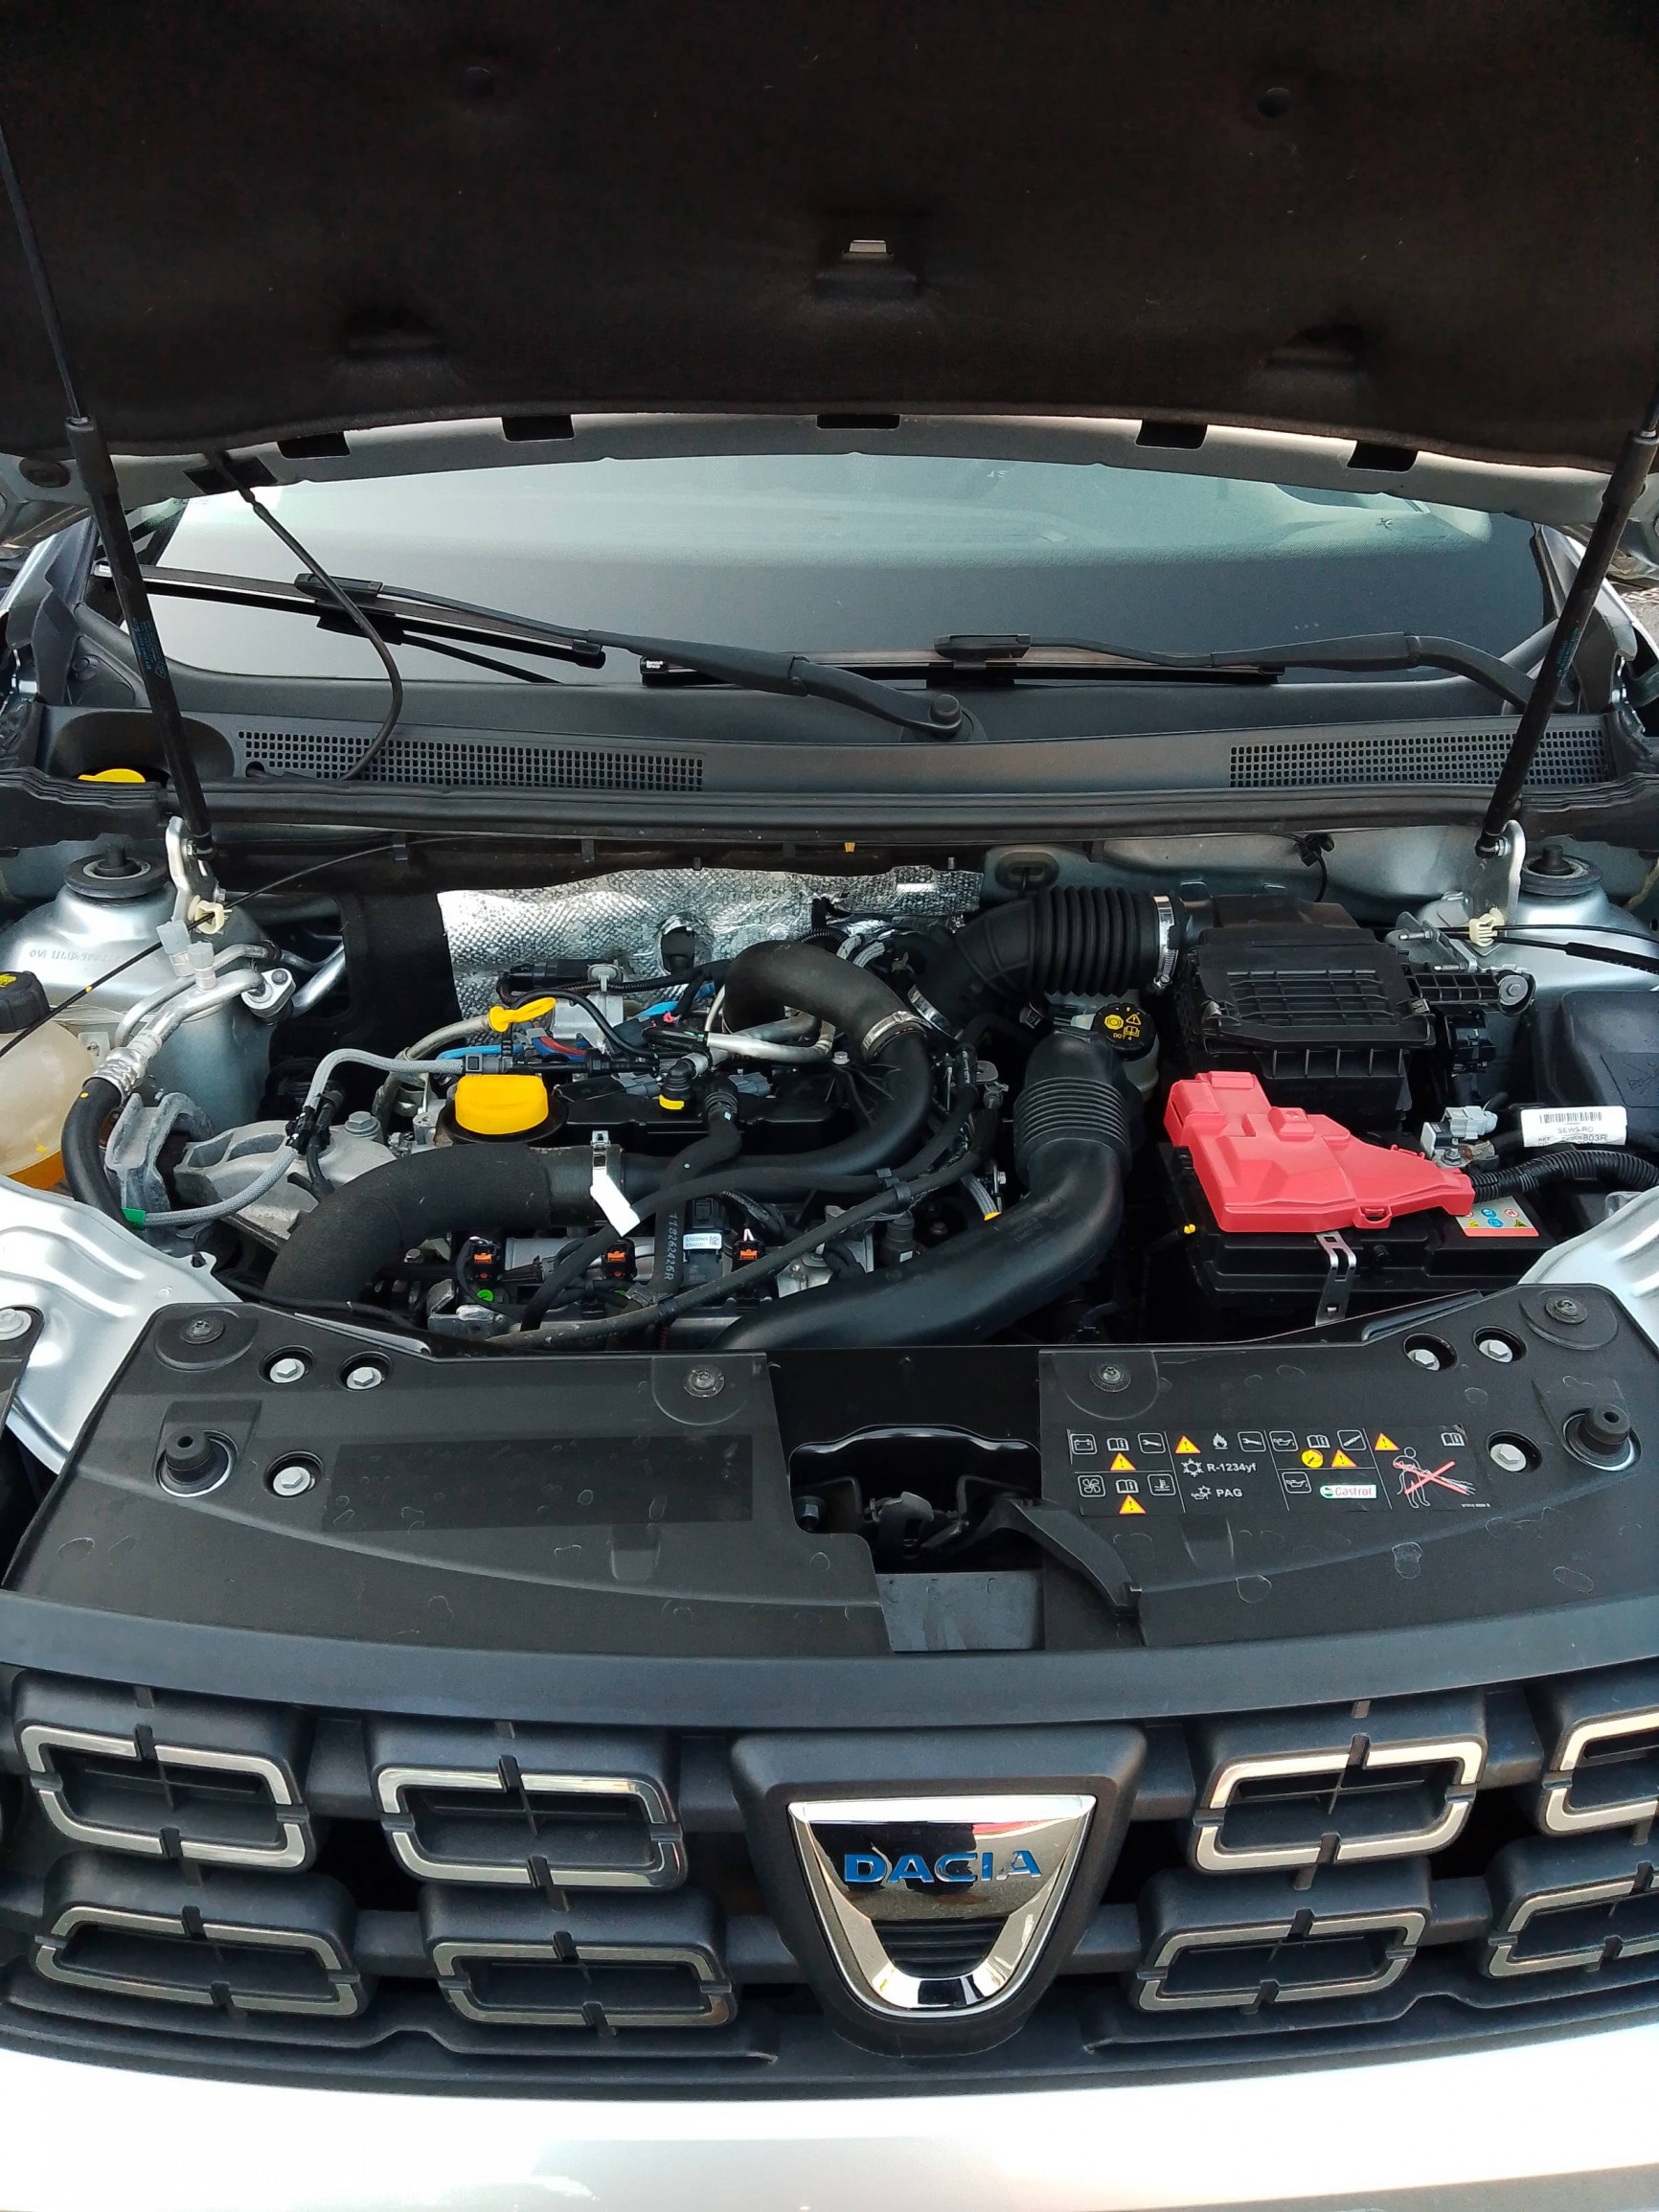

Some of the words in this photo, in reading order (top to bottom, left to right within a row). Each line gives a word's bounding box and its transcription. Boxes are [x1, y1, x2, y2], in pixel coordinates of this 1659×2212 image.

[1207, 1463, 1257, 1473] R-1234yf
[1216, 1489, 1243, 1497] PAG
[1335, 1487, 1372, 1496] Castrol
[845, 1850, 1042, 1883] DACIA
